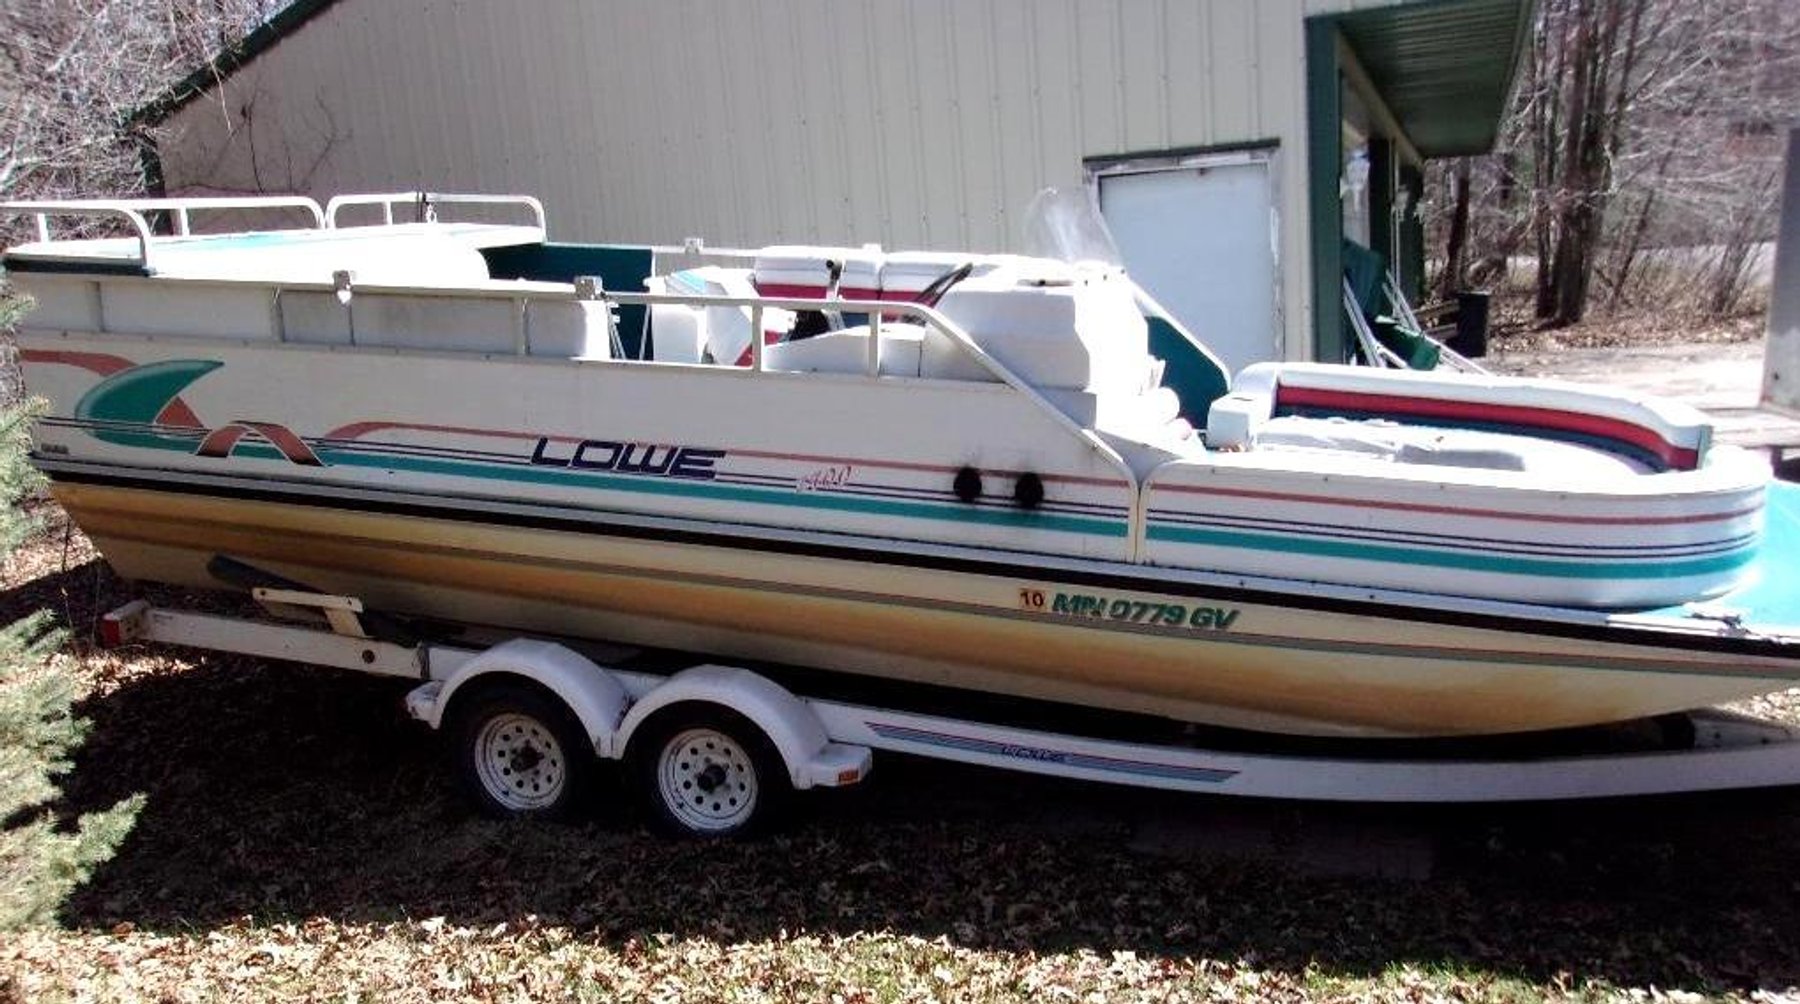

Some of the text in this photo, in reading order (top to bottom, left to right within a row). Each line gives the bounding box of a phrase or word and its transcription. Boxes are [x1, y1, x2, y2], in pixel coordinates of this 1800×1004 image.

[531, 436, 726, 479] LOWE
[1020, 590, 1045, 608] 10
[1051, 592, 1240, 630] MN 0779 GV
